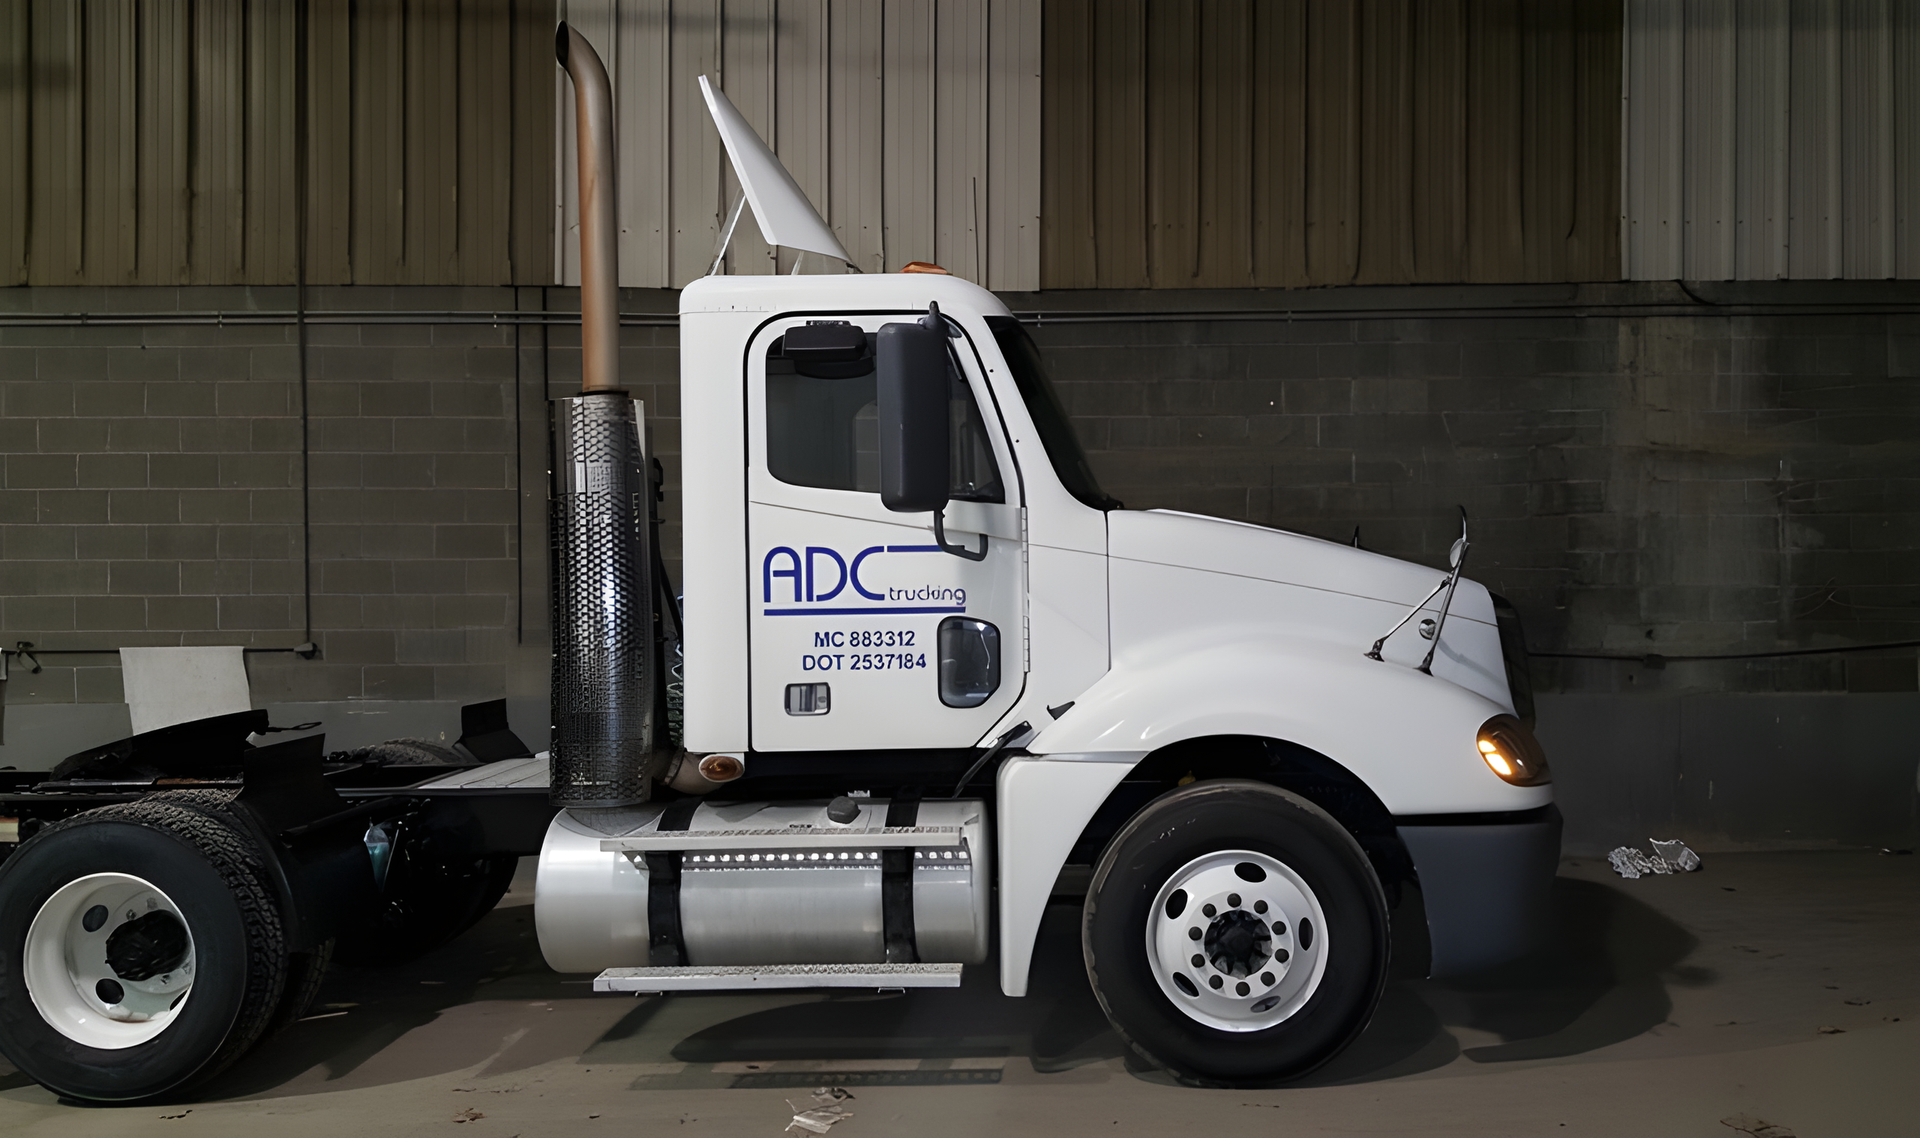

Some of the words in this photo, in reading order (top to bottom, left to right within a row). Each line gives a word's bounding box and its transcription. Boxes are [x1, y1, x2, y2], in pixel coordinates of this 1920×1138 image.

[763, 546, 885, 602] ADC
[889, 585, 966, 605] trucking
[814, 631, 845, 648] MC
[849, 631, 916, 648] 883312
[802, 654, 845, 671] DOT
[850, 653, 927, 671] 2537184
